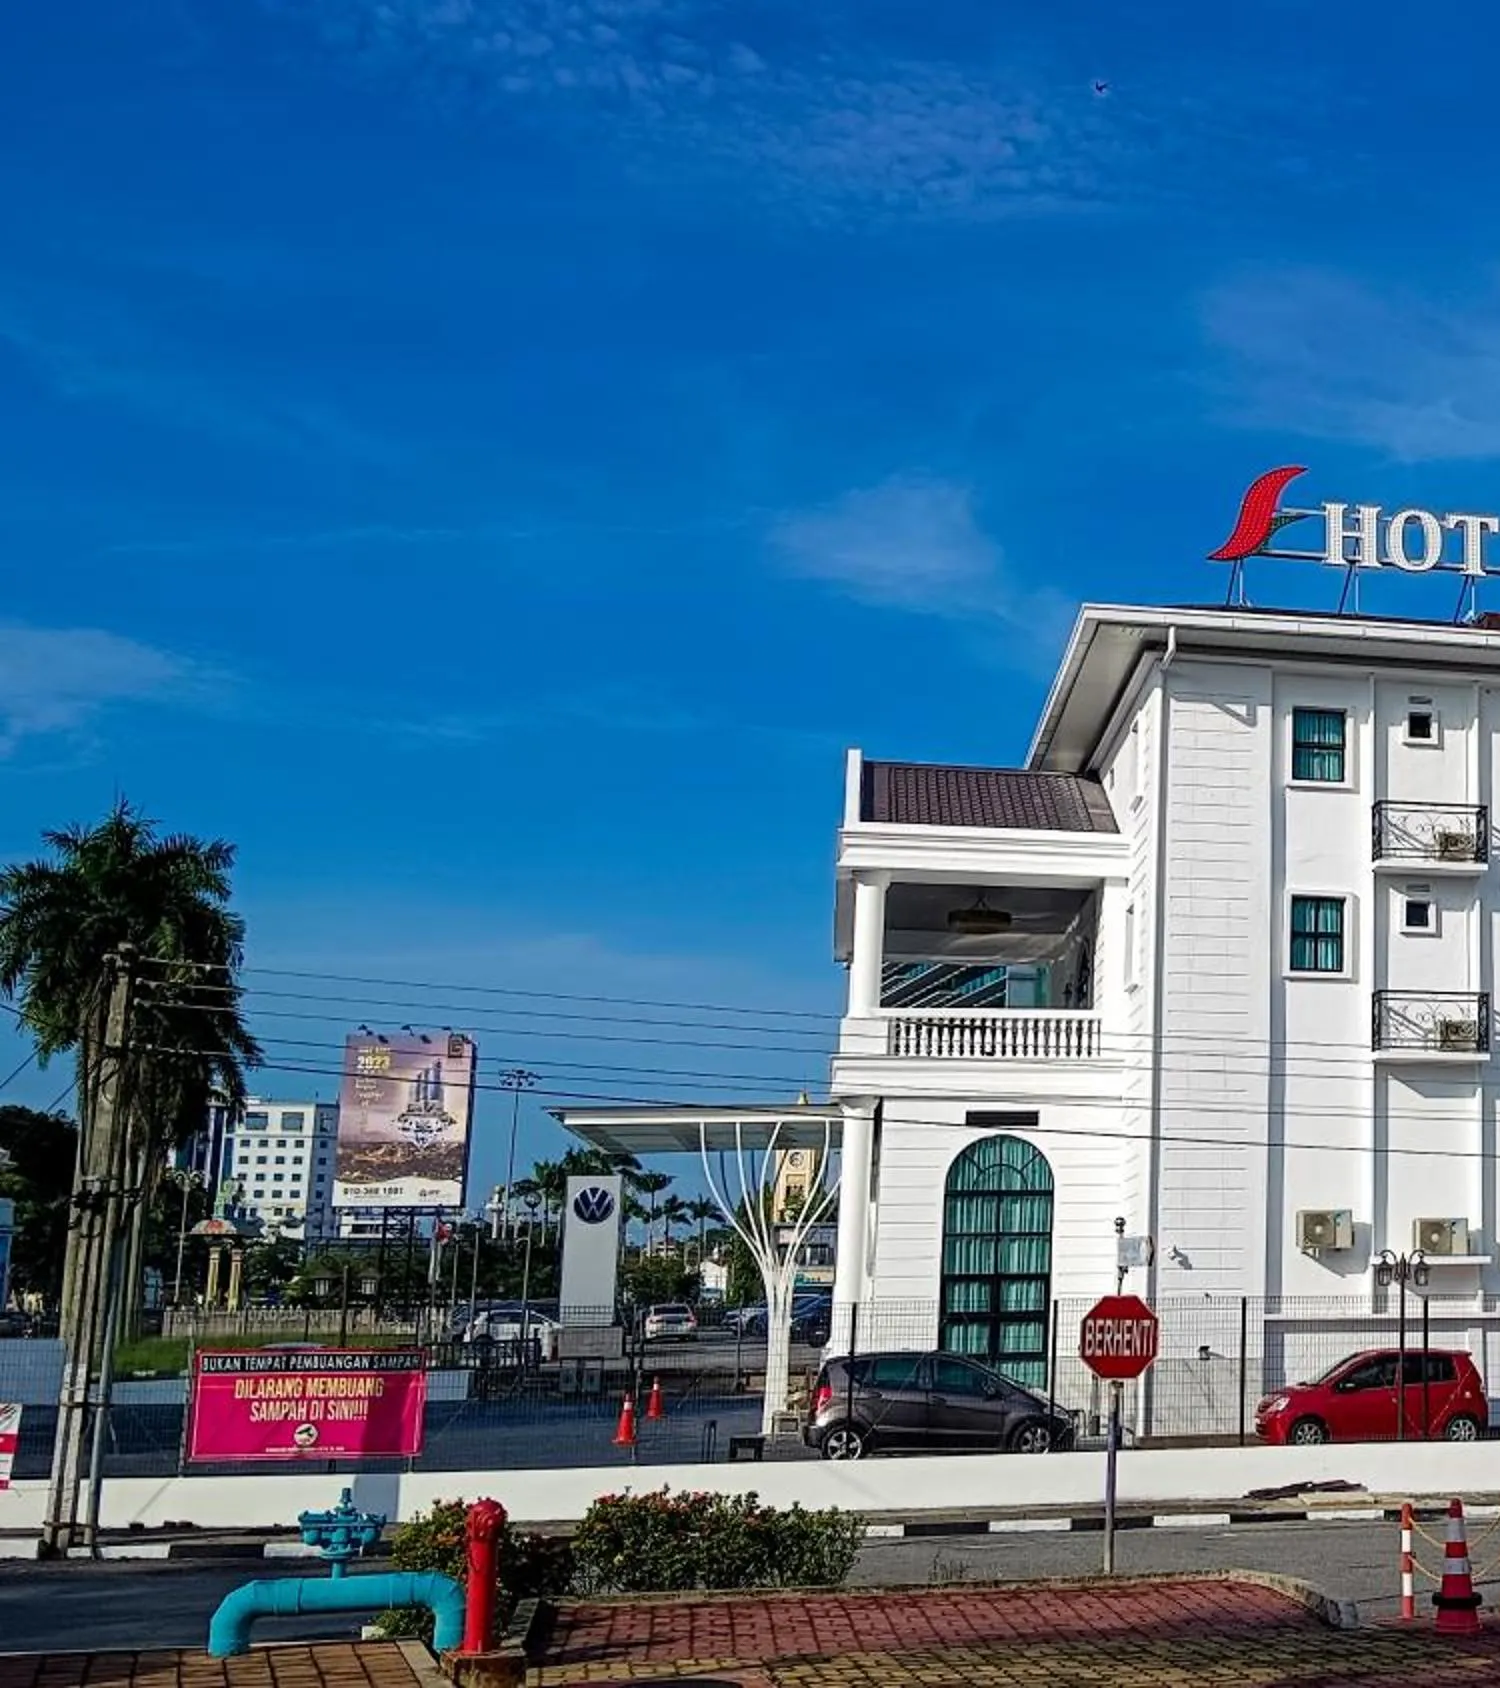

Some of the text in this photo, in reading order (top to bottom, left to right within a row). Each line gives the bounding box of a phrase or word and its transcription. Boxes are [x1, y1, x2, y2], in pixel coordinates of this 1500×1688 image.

[1084, 1318, 1156, 1357] BERHENTI
[203, 1355, 420, 1371] BUKAN TEMPAT PEMBUANGAN SAMPAH
[235, 1377, 384, 1399] DILARANG MEMBUANG
[250, 1401, 306, 1422] SAMPAH
[309, 1401, 324, 1421] DI
